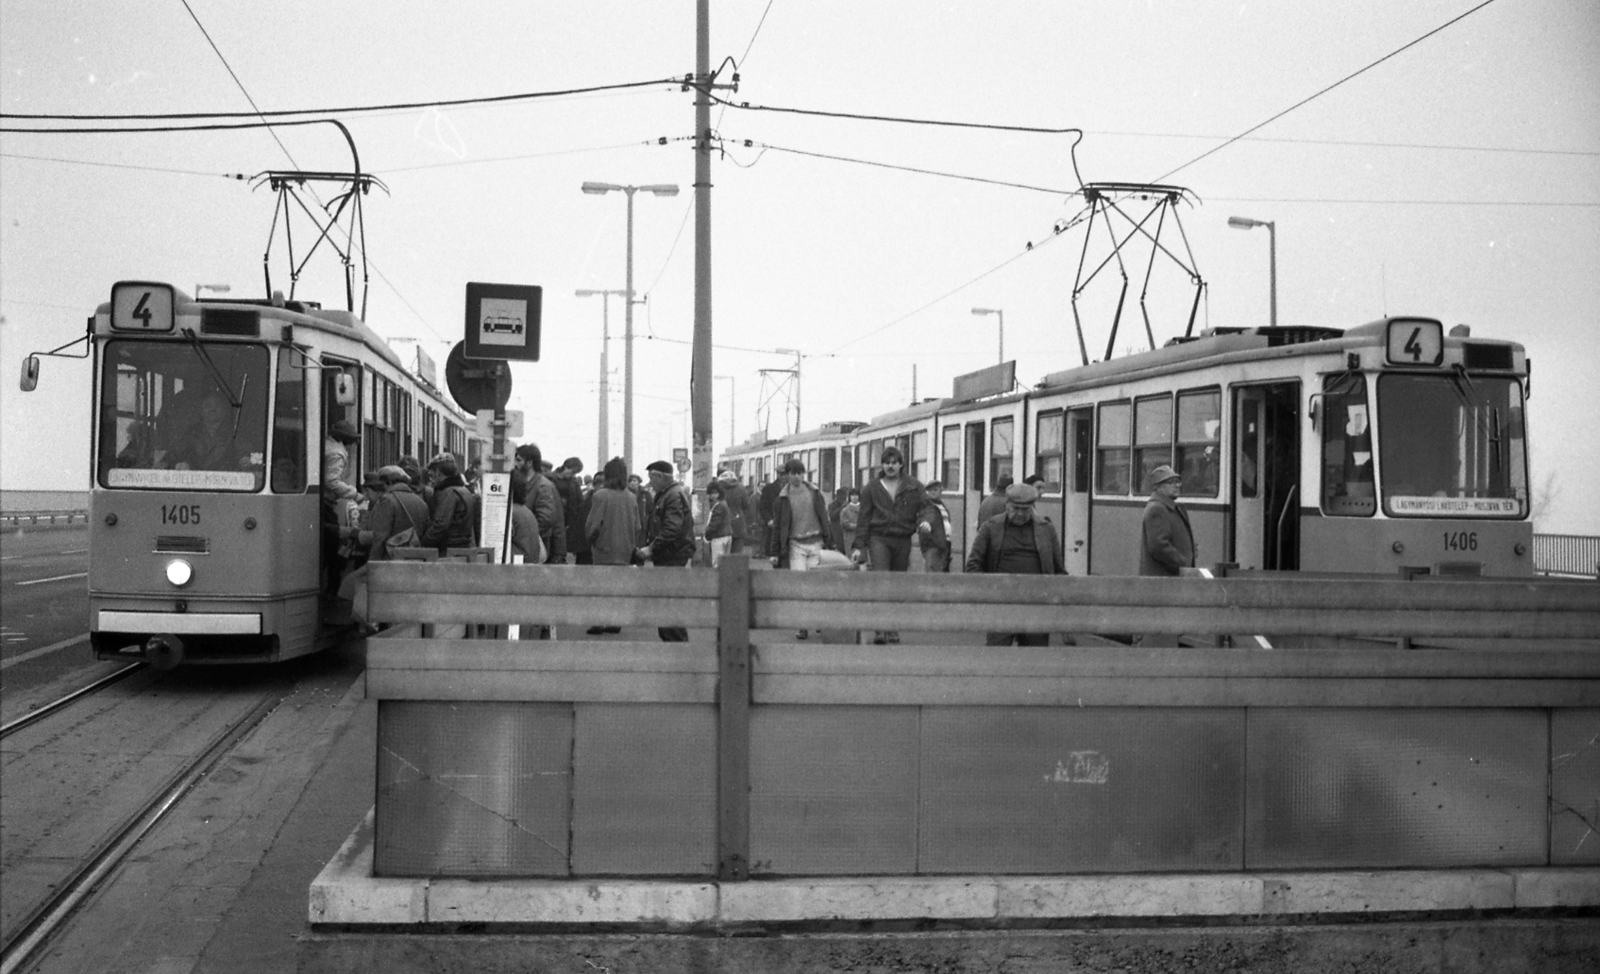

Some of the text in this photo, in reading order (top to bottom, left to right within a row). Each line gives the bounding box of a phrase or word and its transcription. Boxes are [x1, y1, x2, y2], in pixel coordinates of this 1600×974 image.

[132, 292, 152, 328] 4
[1404, 327, 1422, 361] 4
[162, 504, 201, 525] 1405
[1443, 531, 1478, 551] 1406
